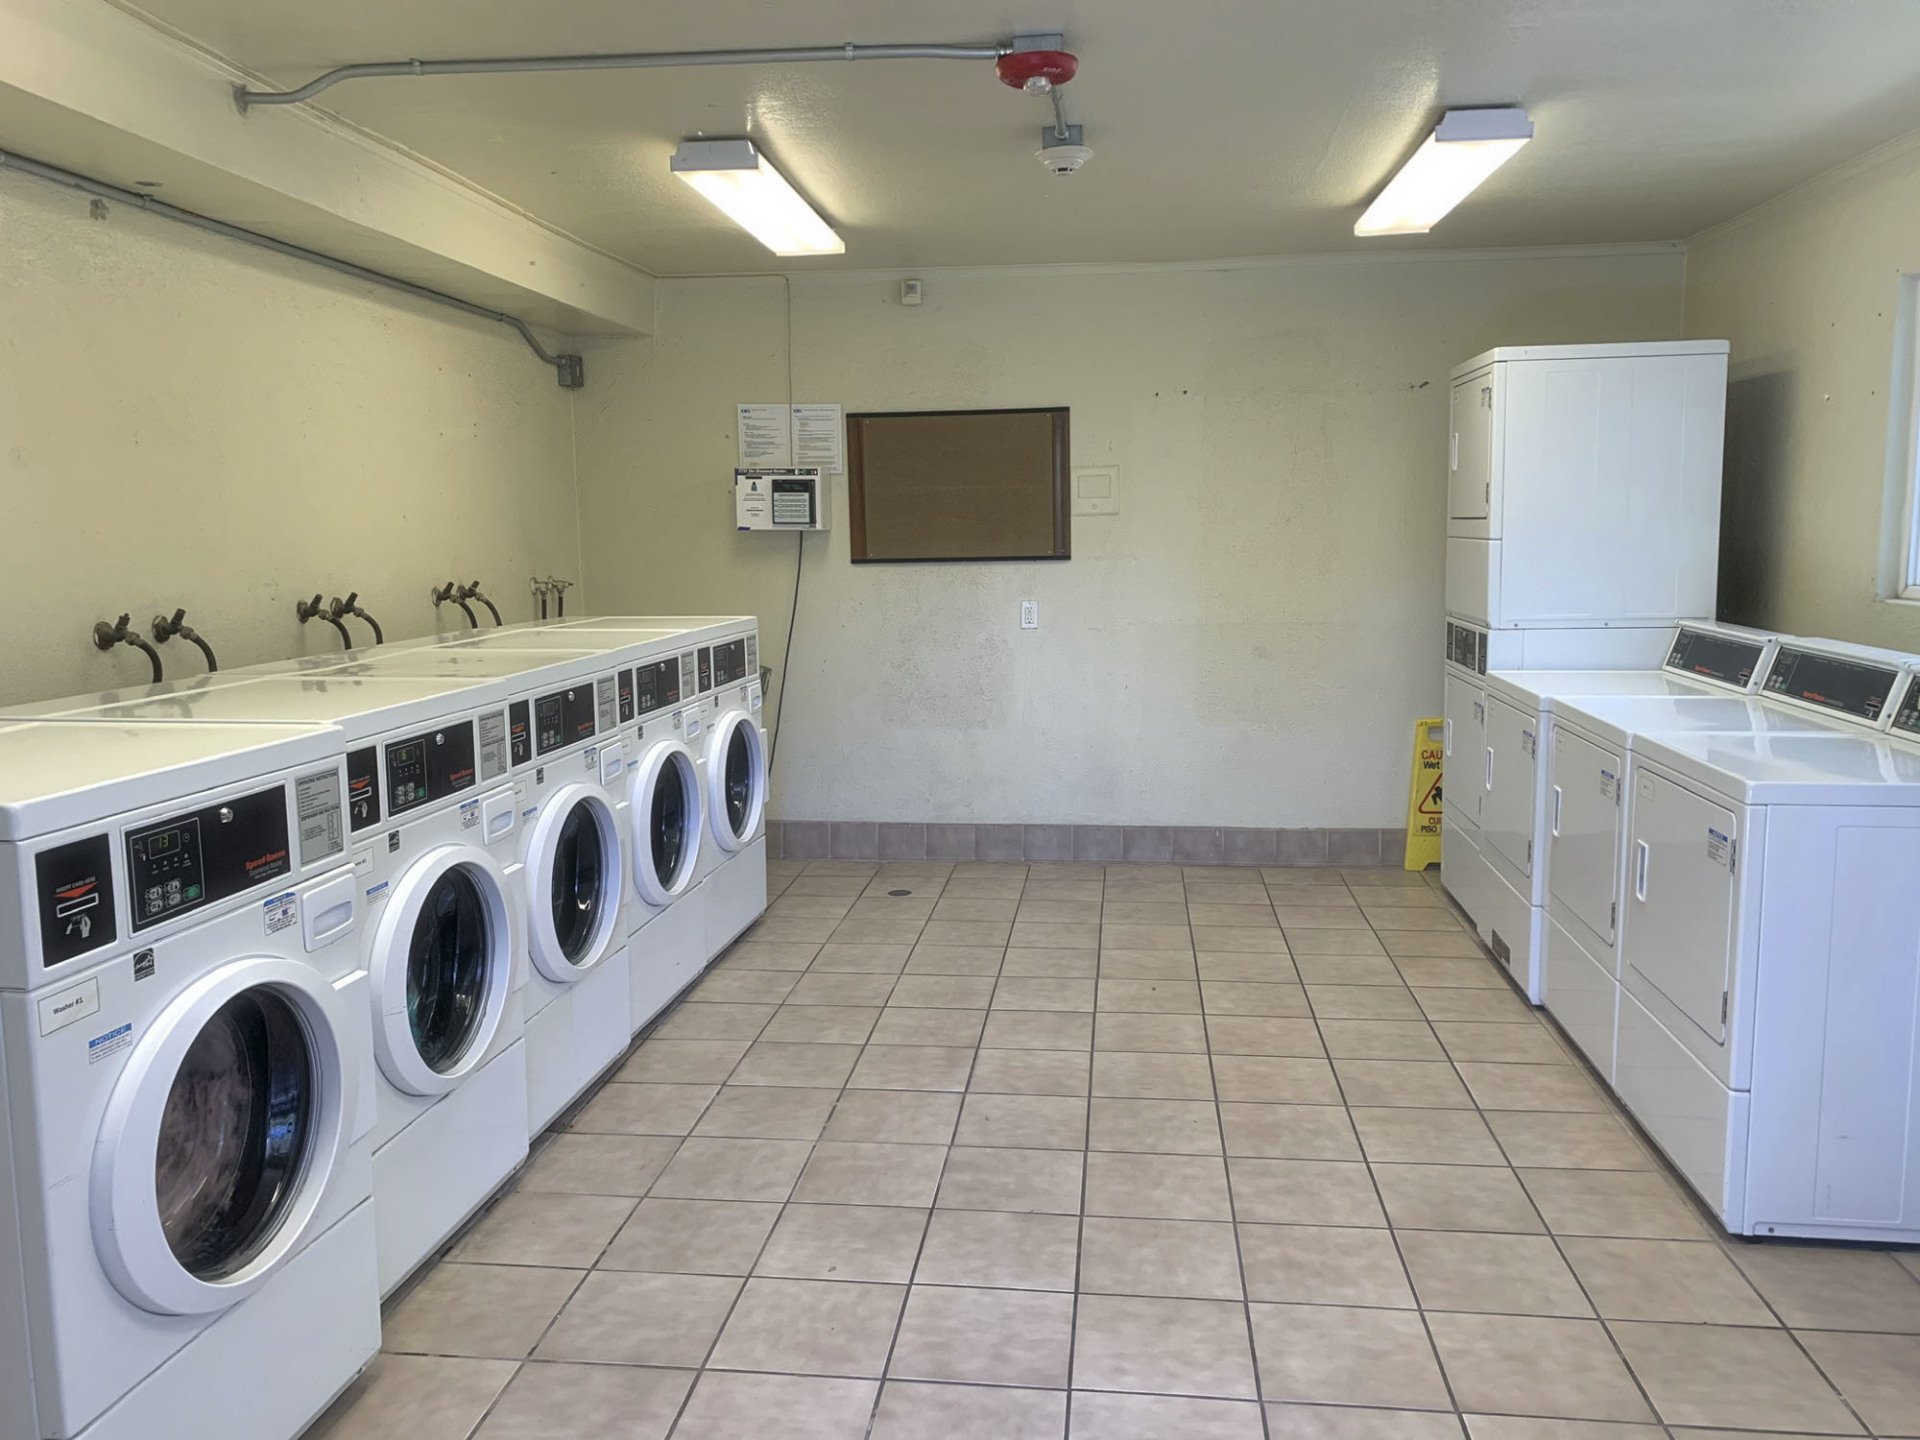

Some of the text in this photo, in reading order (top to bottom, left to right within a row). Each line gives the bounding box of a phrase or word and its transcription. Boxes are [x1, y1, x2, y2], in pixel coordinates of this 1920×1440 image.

[1424, 761, 1441, 769] Wet
[1421, 825, 1437, 833] PISO
[53, 996, 84, 1014] Washer #1
[95, 1028, 126, 1045] NOTICE
